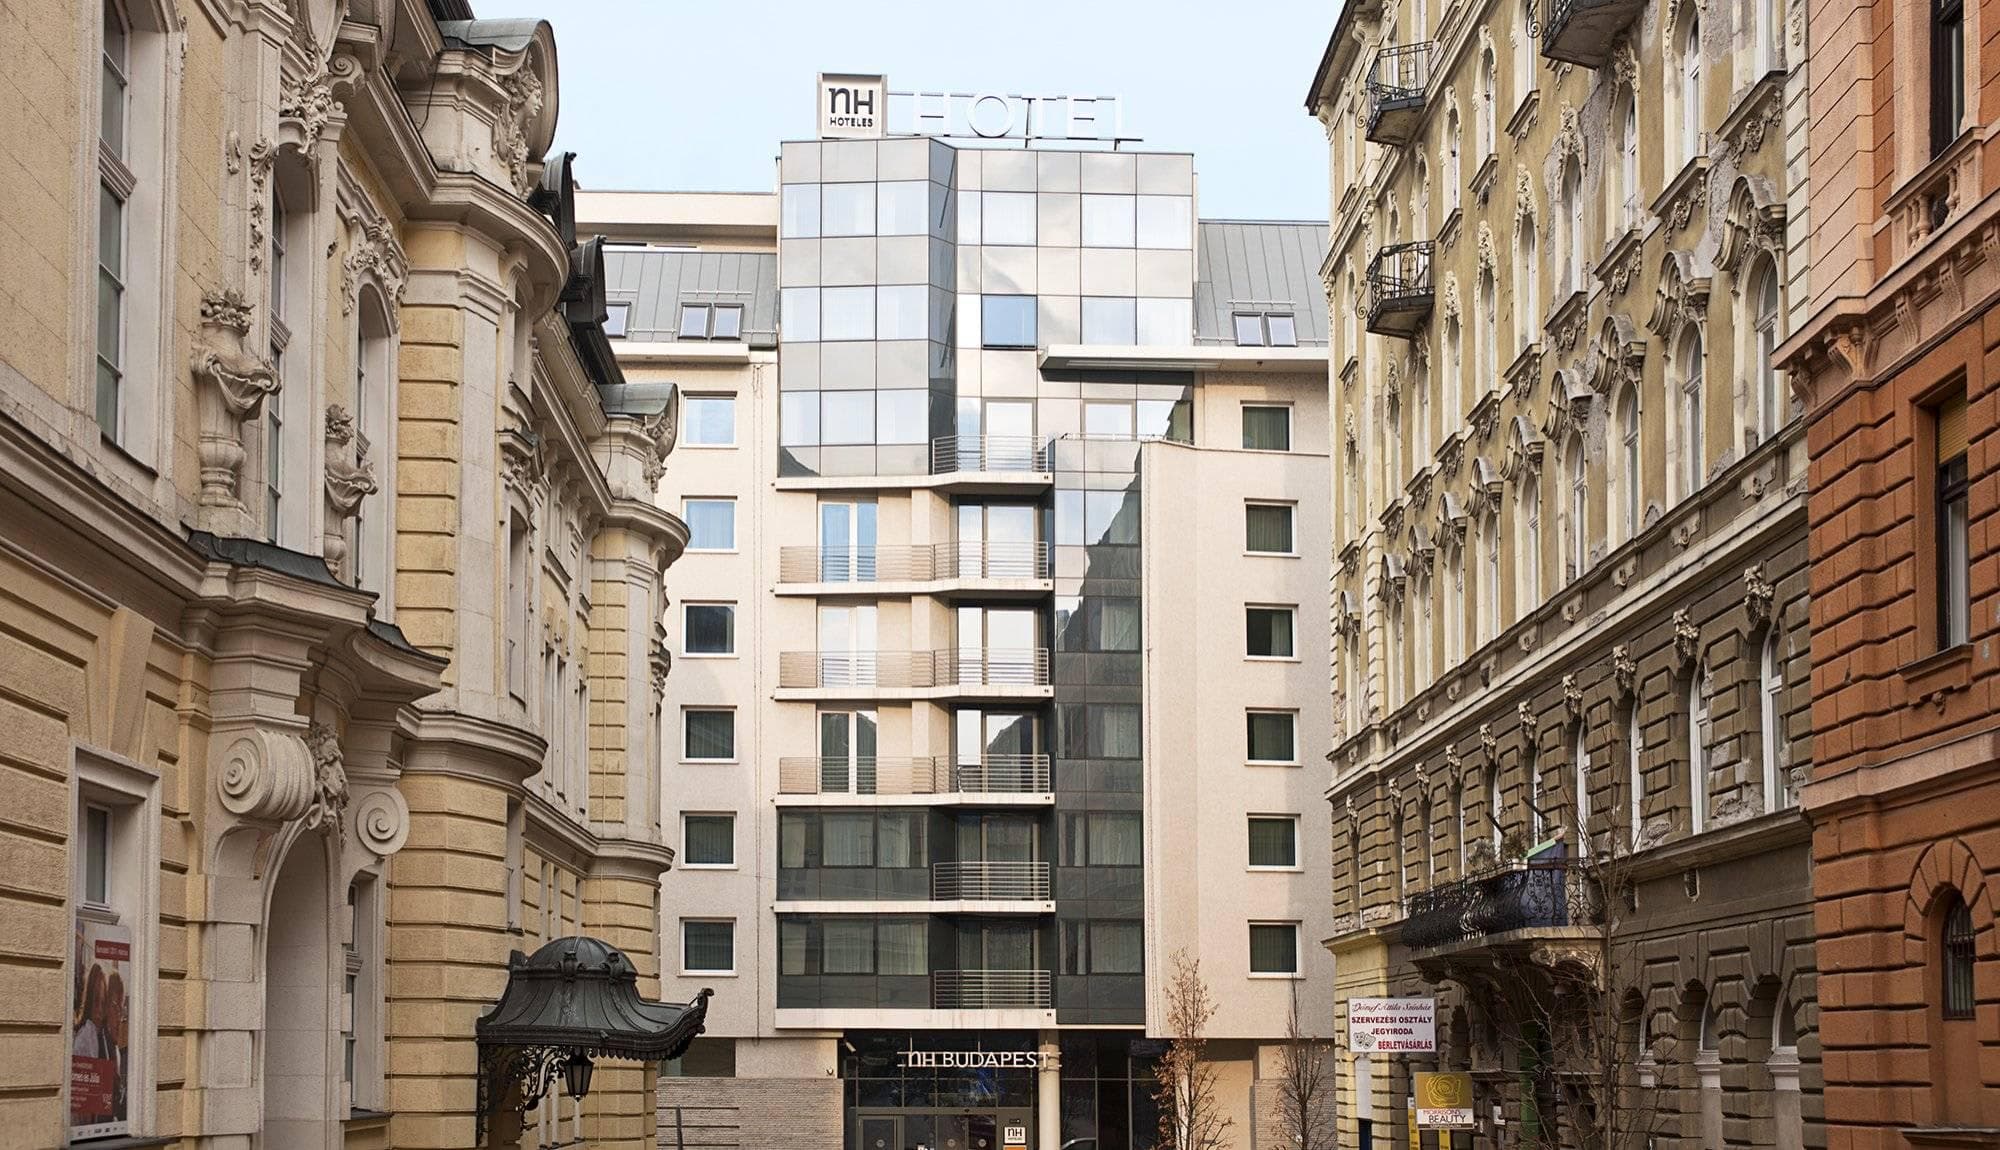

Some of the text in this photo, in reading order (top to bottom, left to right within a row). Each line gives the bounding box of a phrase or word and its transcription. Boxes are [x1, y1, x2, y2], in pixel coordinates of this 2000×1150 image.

[829, 117, 873, 127] HOTELES
[1351, 1015, 1432, 1024] SZERVEZÉSI OSZTÁLY
[1378, 1039, 1432, 1050] BÉRLETVÁSÁRLÁS
[942, 1051, 1050, 1067] BUDAPEST
[1428, 1115, 1466, 1123] BEAUTY
